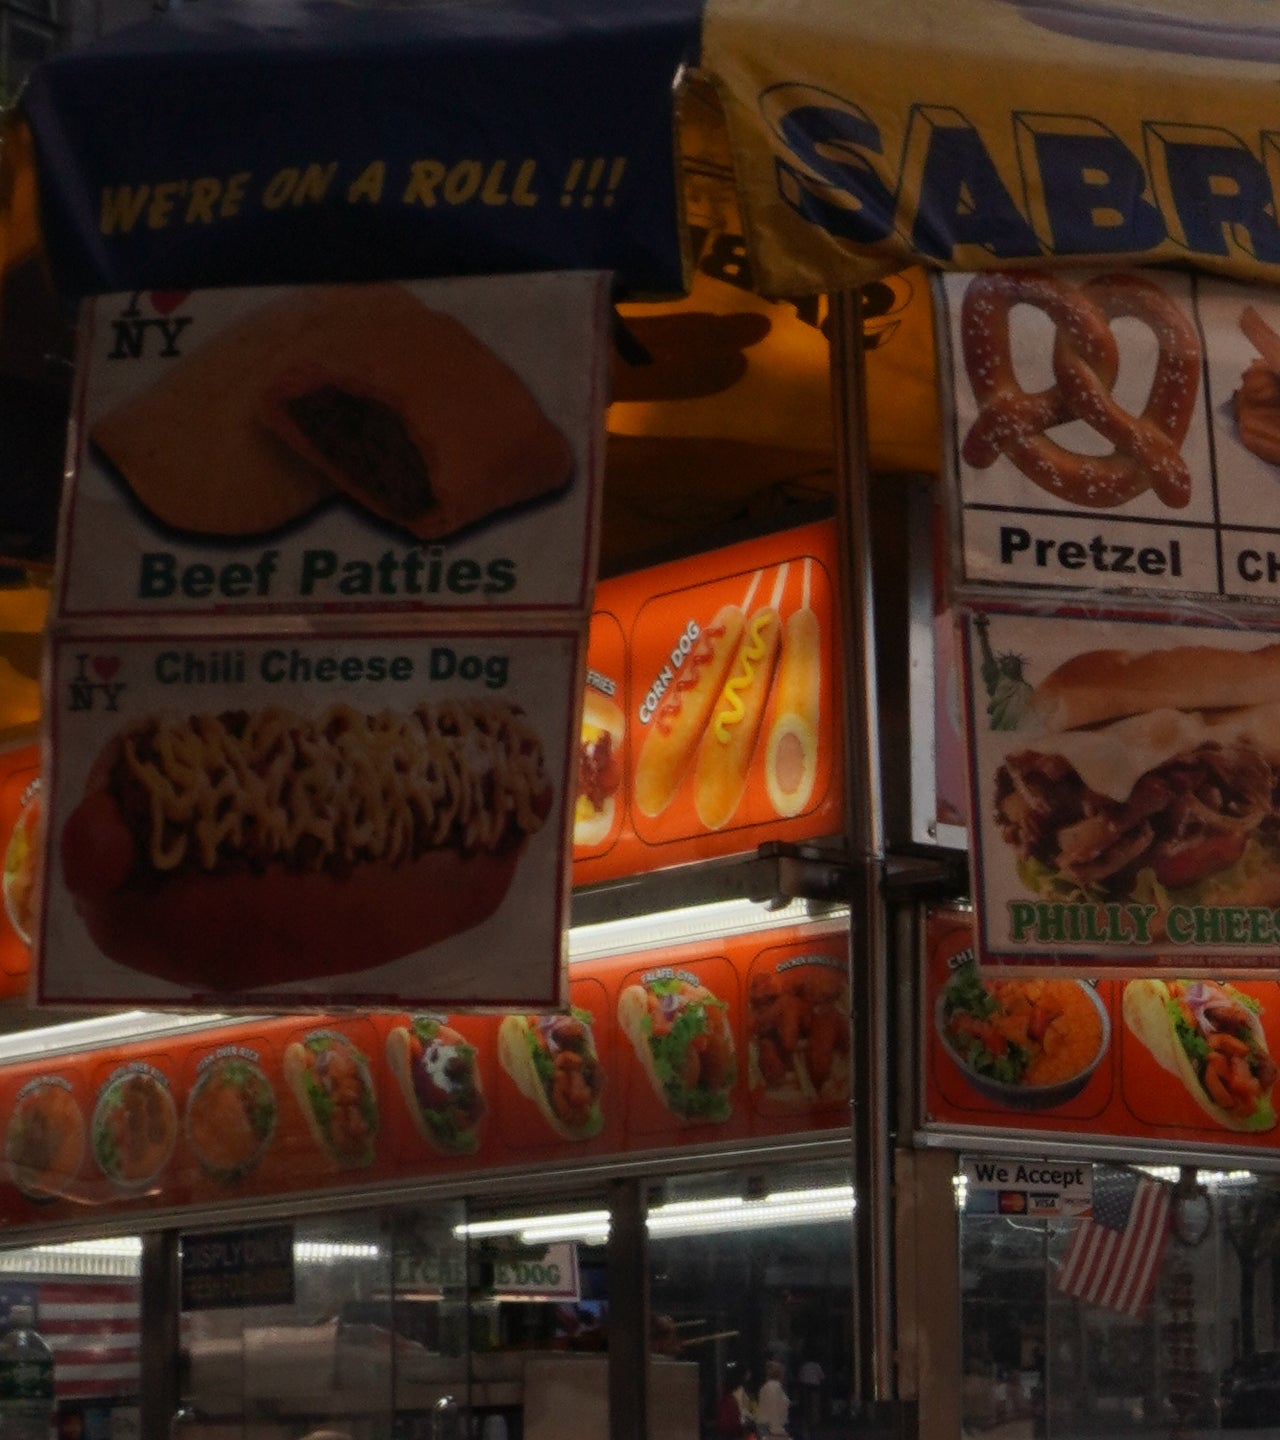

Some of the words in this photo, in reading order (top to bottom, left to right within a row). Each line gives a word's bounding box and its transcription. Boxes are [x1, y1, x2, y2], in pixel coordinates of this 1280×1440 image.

[101, 172, 252, 237] WE'RE
[262, 161, 336, 210] ON
[347, 161, 386, 205] A
[403, 158, 539, 208] ROLL
[108, 317, 194, 360] NY
[140, 550, 279, 599] Beef
[301, 546, 517, 595] Patties
[1000, 527, 1182, 577] Pretzel
[73, 654, 88, 683] I
[155, 651, 246, 686] Chili
[261, 650, 413, 685] Cheese
[428, 647, 510, 689] Dog
[638, 665, 674, 725] CORN
[671, 620, 701, 669] DOG
[69, 684, 125, 712] NY
[1009, 902, 1157, 945] PHILLY
[975, 1163, 1009, 1182] We
[1015, 1165, 1084, 1189] Accept
